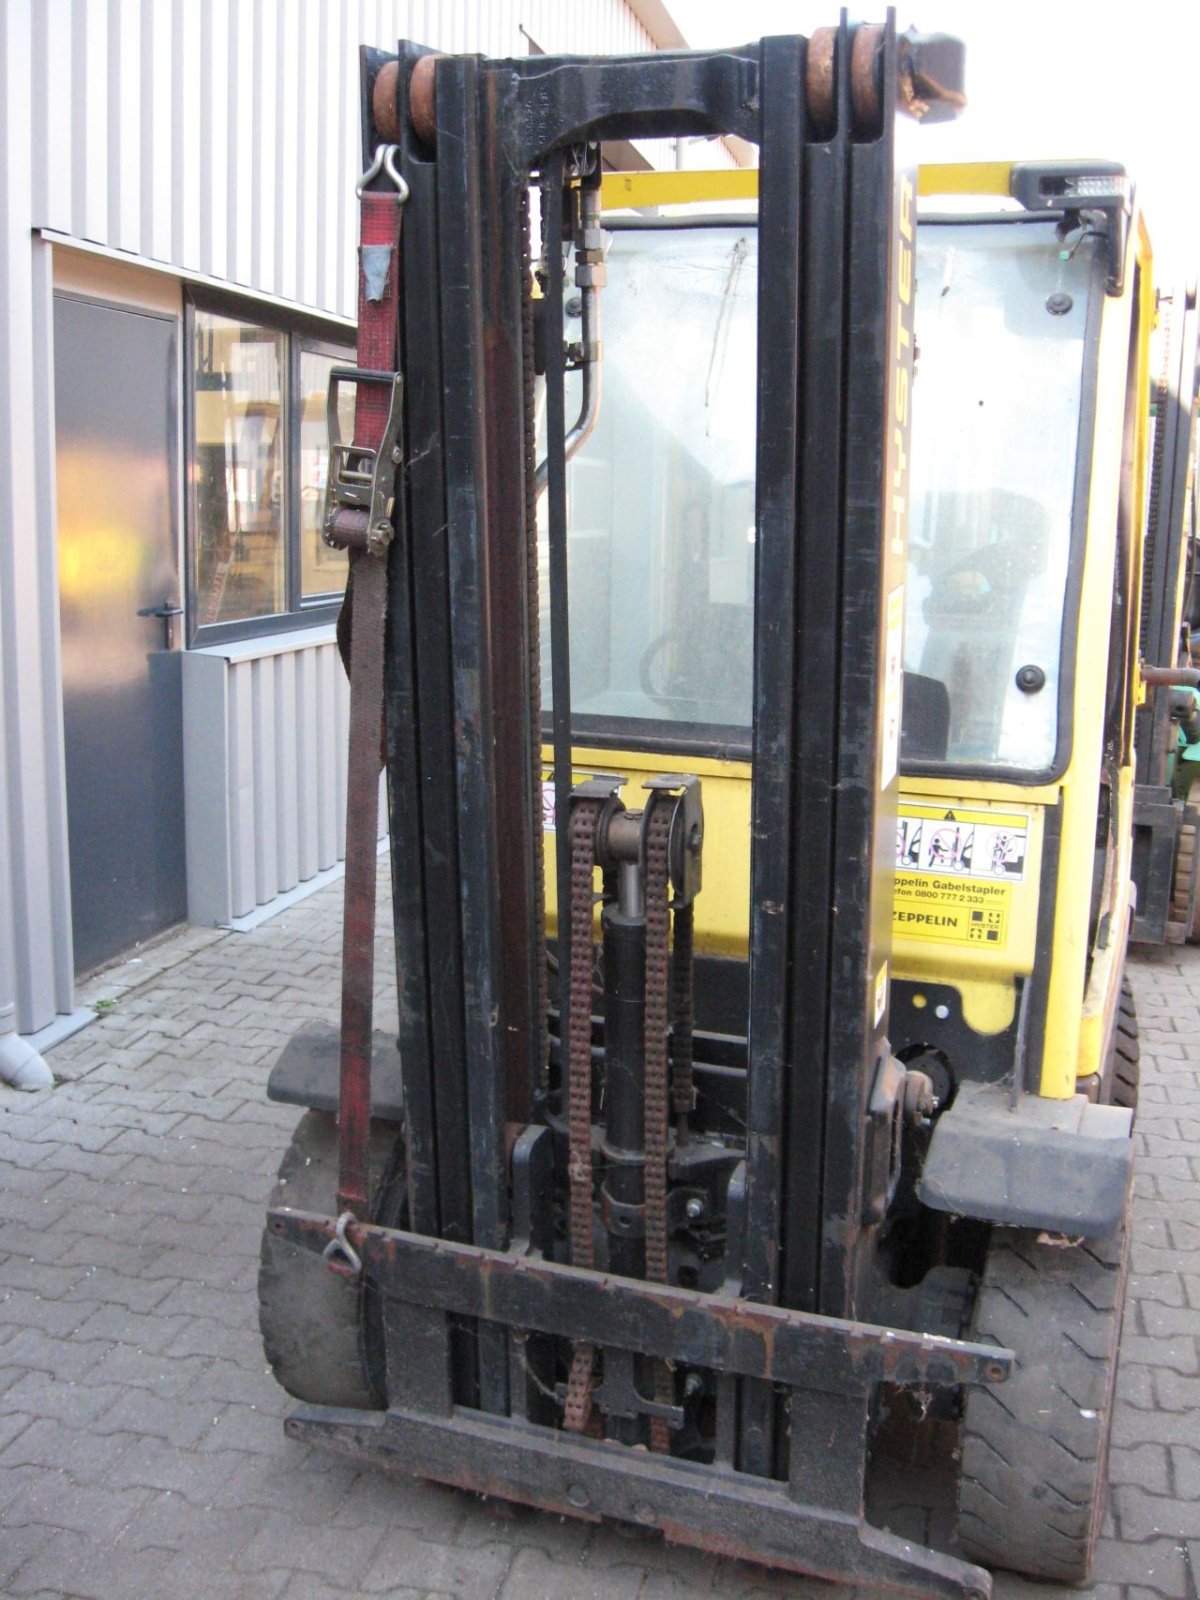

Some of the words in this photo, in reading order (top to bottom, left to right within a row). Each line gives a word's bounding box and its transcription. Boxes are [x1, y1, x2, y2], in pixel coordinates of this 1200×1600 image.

[892, 174, 913, 556] HYSTER
[932, 880, 1006, 896] Gabelstapler
[915, 890, 939, 899] 0800
[941, 892, 958, 901] 777
[959, 894, 965, 902] 2
[966, 895, 985, 904] 333
